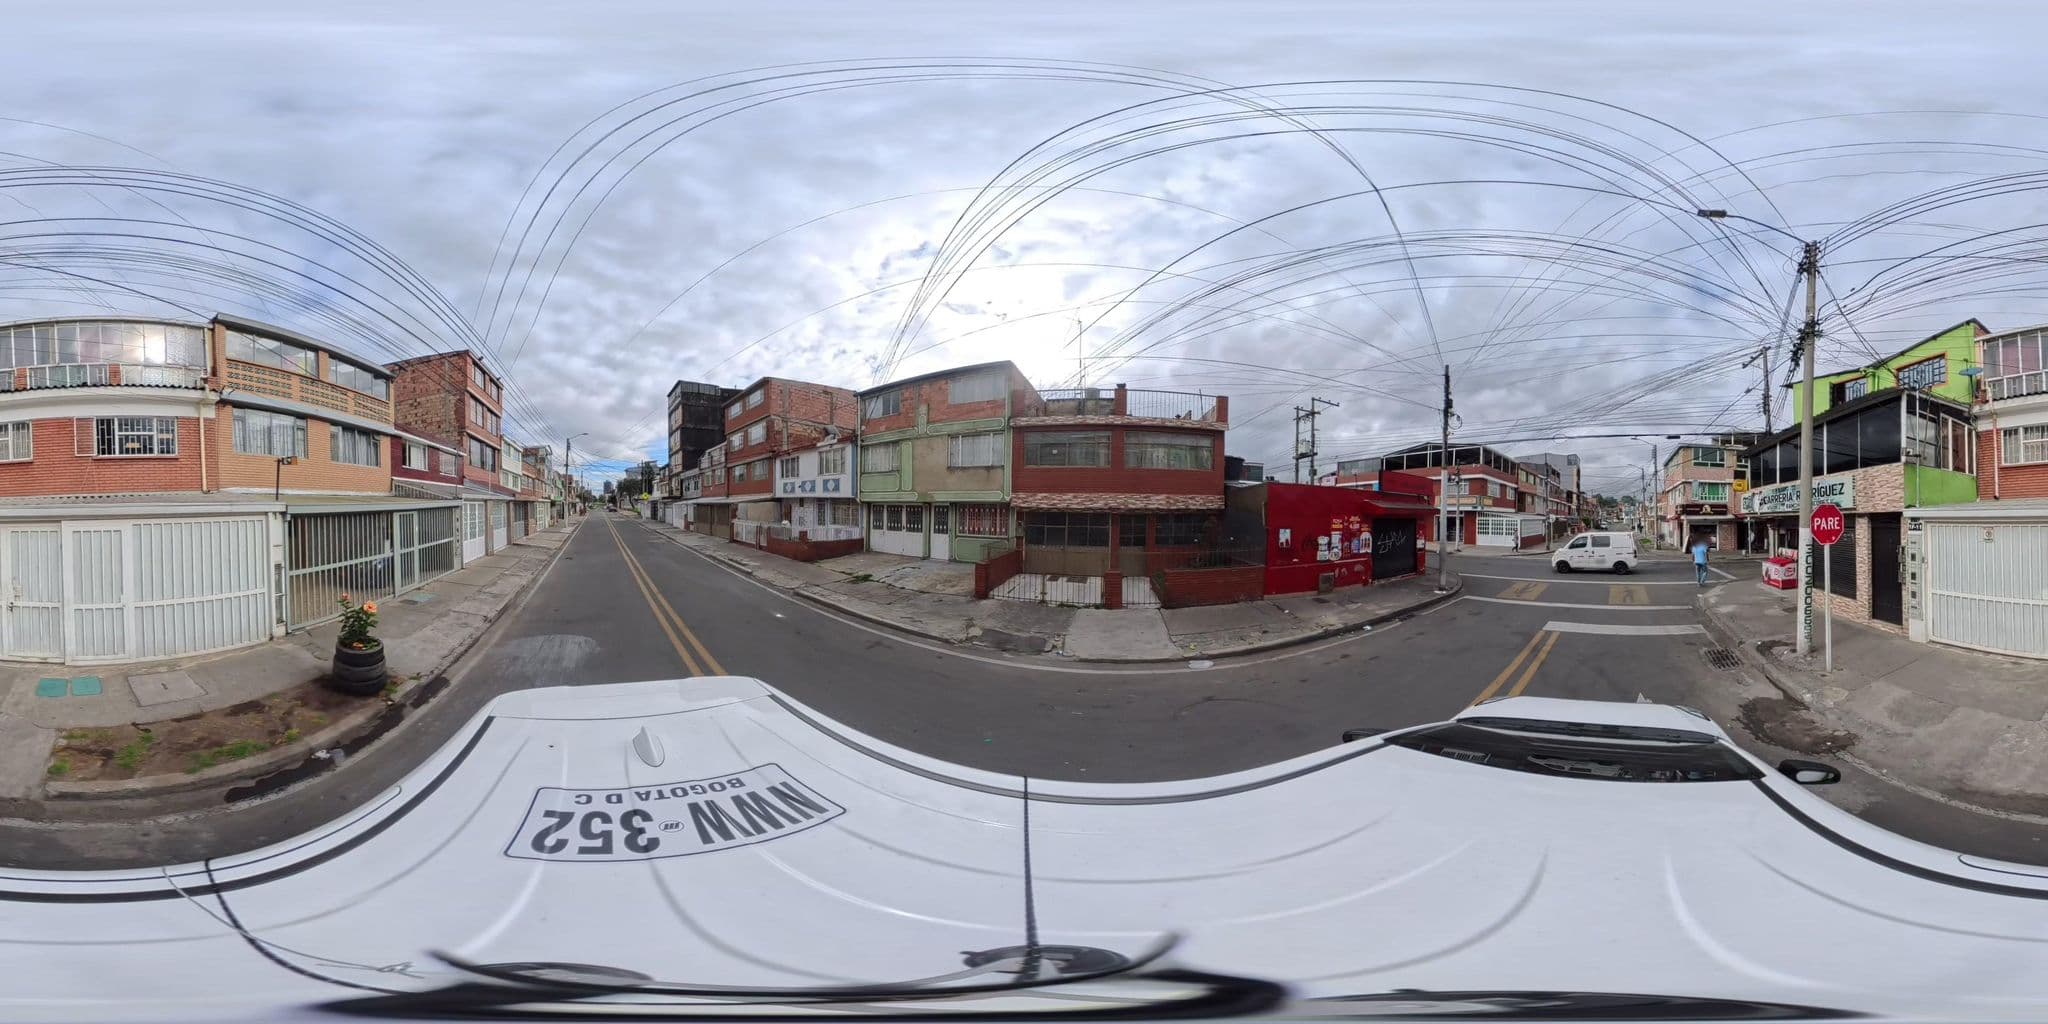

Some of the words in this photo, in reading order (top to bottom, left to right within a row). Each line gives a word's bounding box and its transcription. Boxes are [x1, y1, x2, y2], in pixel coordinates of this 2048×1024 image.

[1795, 482, 1845, 501] RRÍGUEZ
[1814, 517, 1840, 530] PARE
[574, 793, 593, 805] C
[605, 793, 623, 804] D
[634, 777, 746, 802] BOGOTA
[688, 781, 829, 845] NWW
[530, 808, 660, 855] 352
